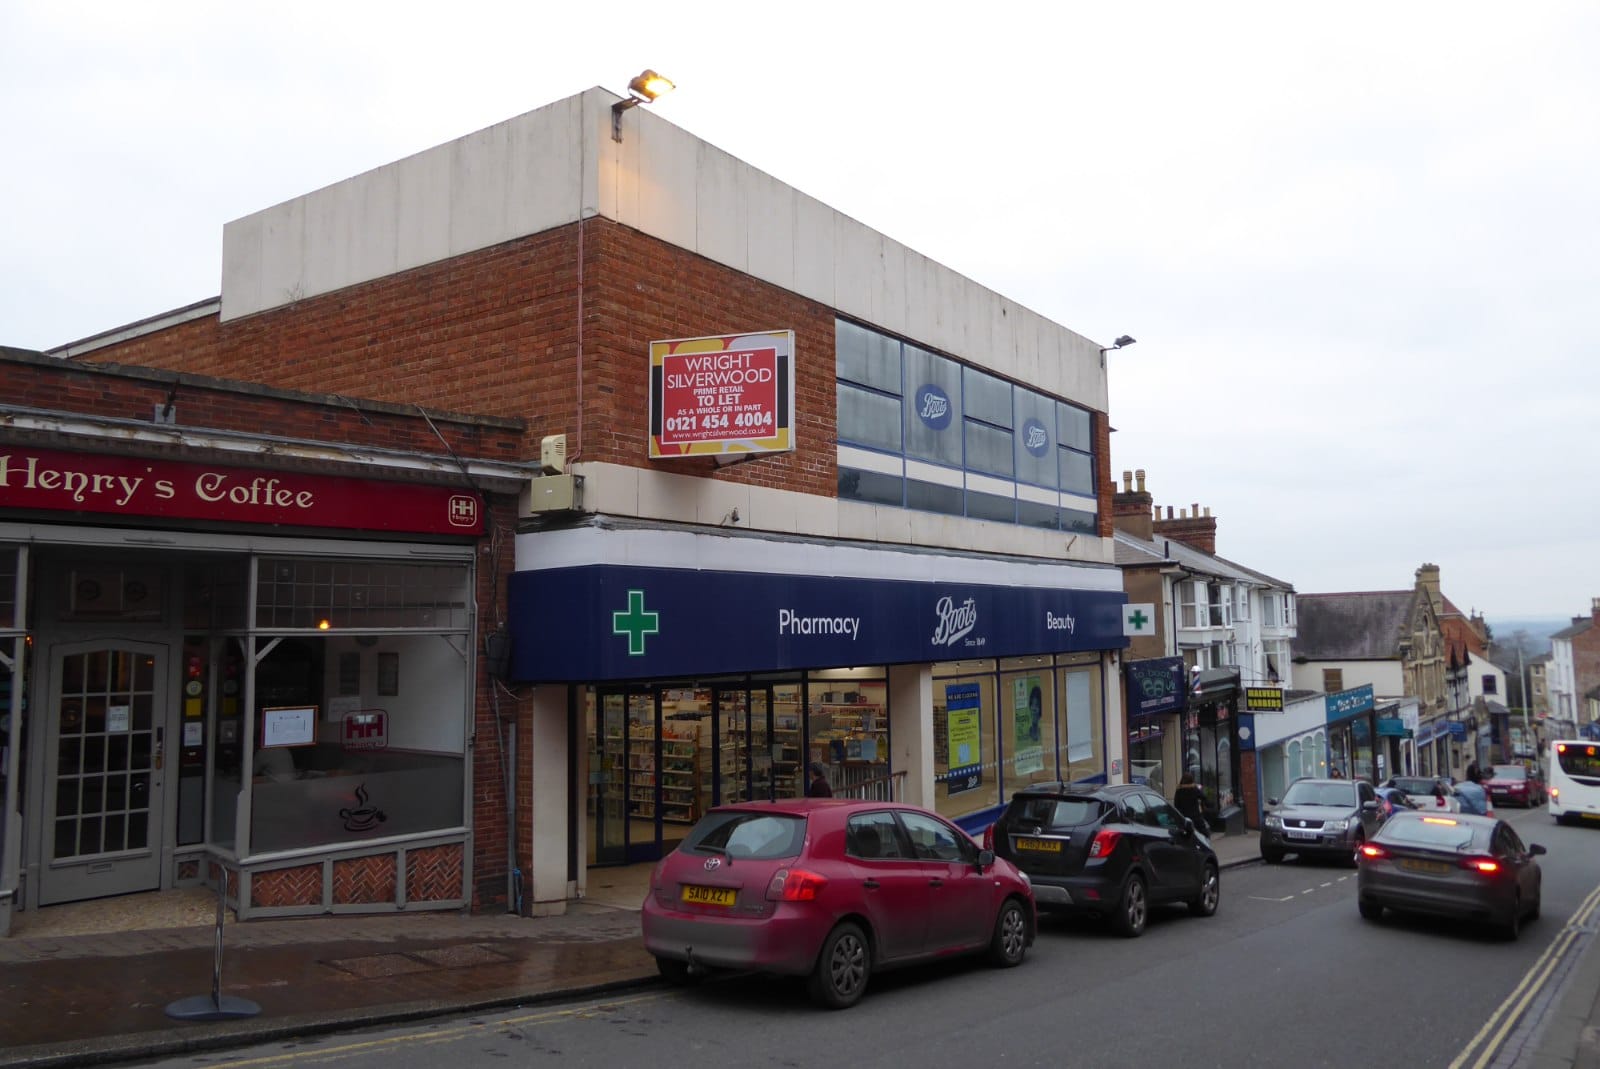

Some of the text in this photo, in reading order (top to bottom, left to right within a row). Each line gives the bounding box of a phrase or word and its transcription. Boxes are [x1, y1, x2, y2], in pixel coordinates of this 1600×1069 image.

[685, 353, 754, 371] WRIGHT
[667, 368, 772, 389] SILVERWOOD
[693, 385, 744, 396] PRIME RETAIL
[697, 393, 741, 407] TO LET
[696, 406, 720, 414] WHOLE
[921, 393, 947, 419] Boots
[666, 411, 772, 431] 0121 454 4004
[1027, 426, 1046, 448] Boots
[0, 455, 314, 508] Henry's Coffee
[779, 608, 860, 641] Pharmacy
[931, 595, 977, 647] Boots
[1047, 611, 1075, 635] Beauty
